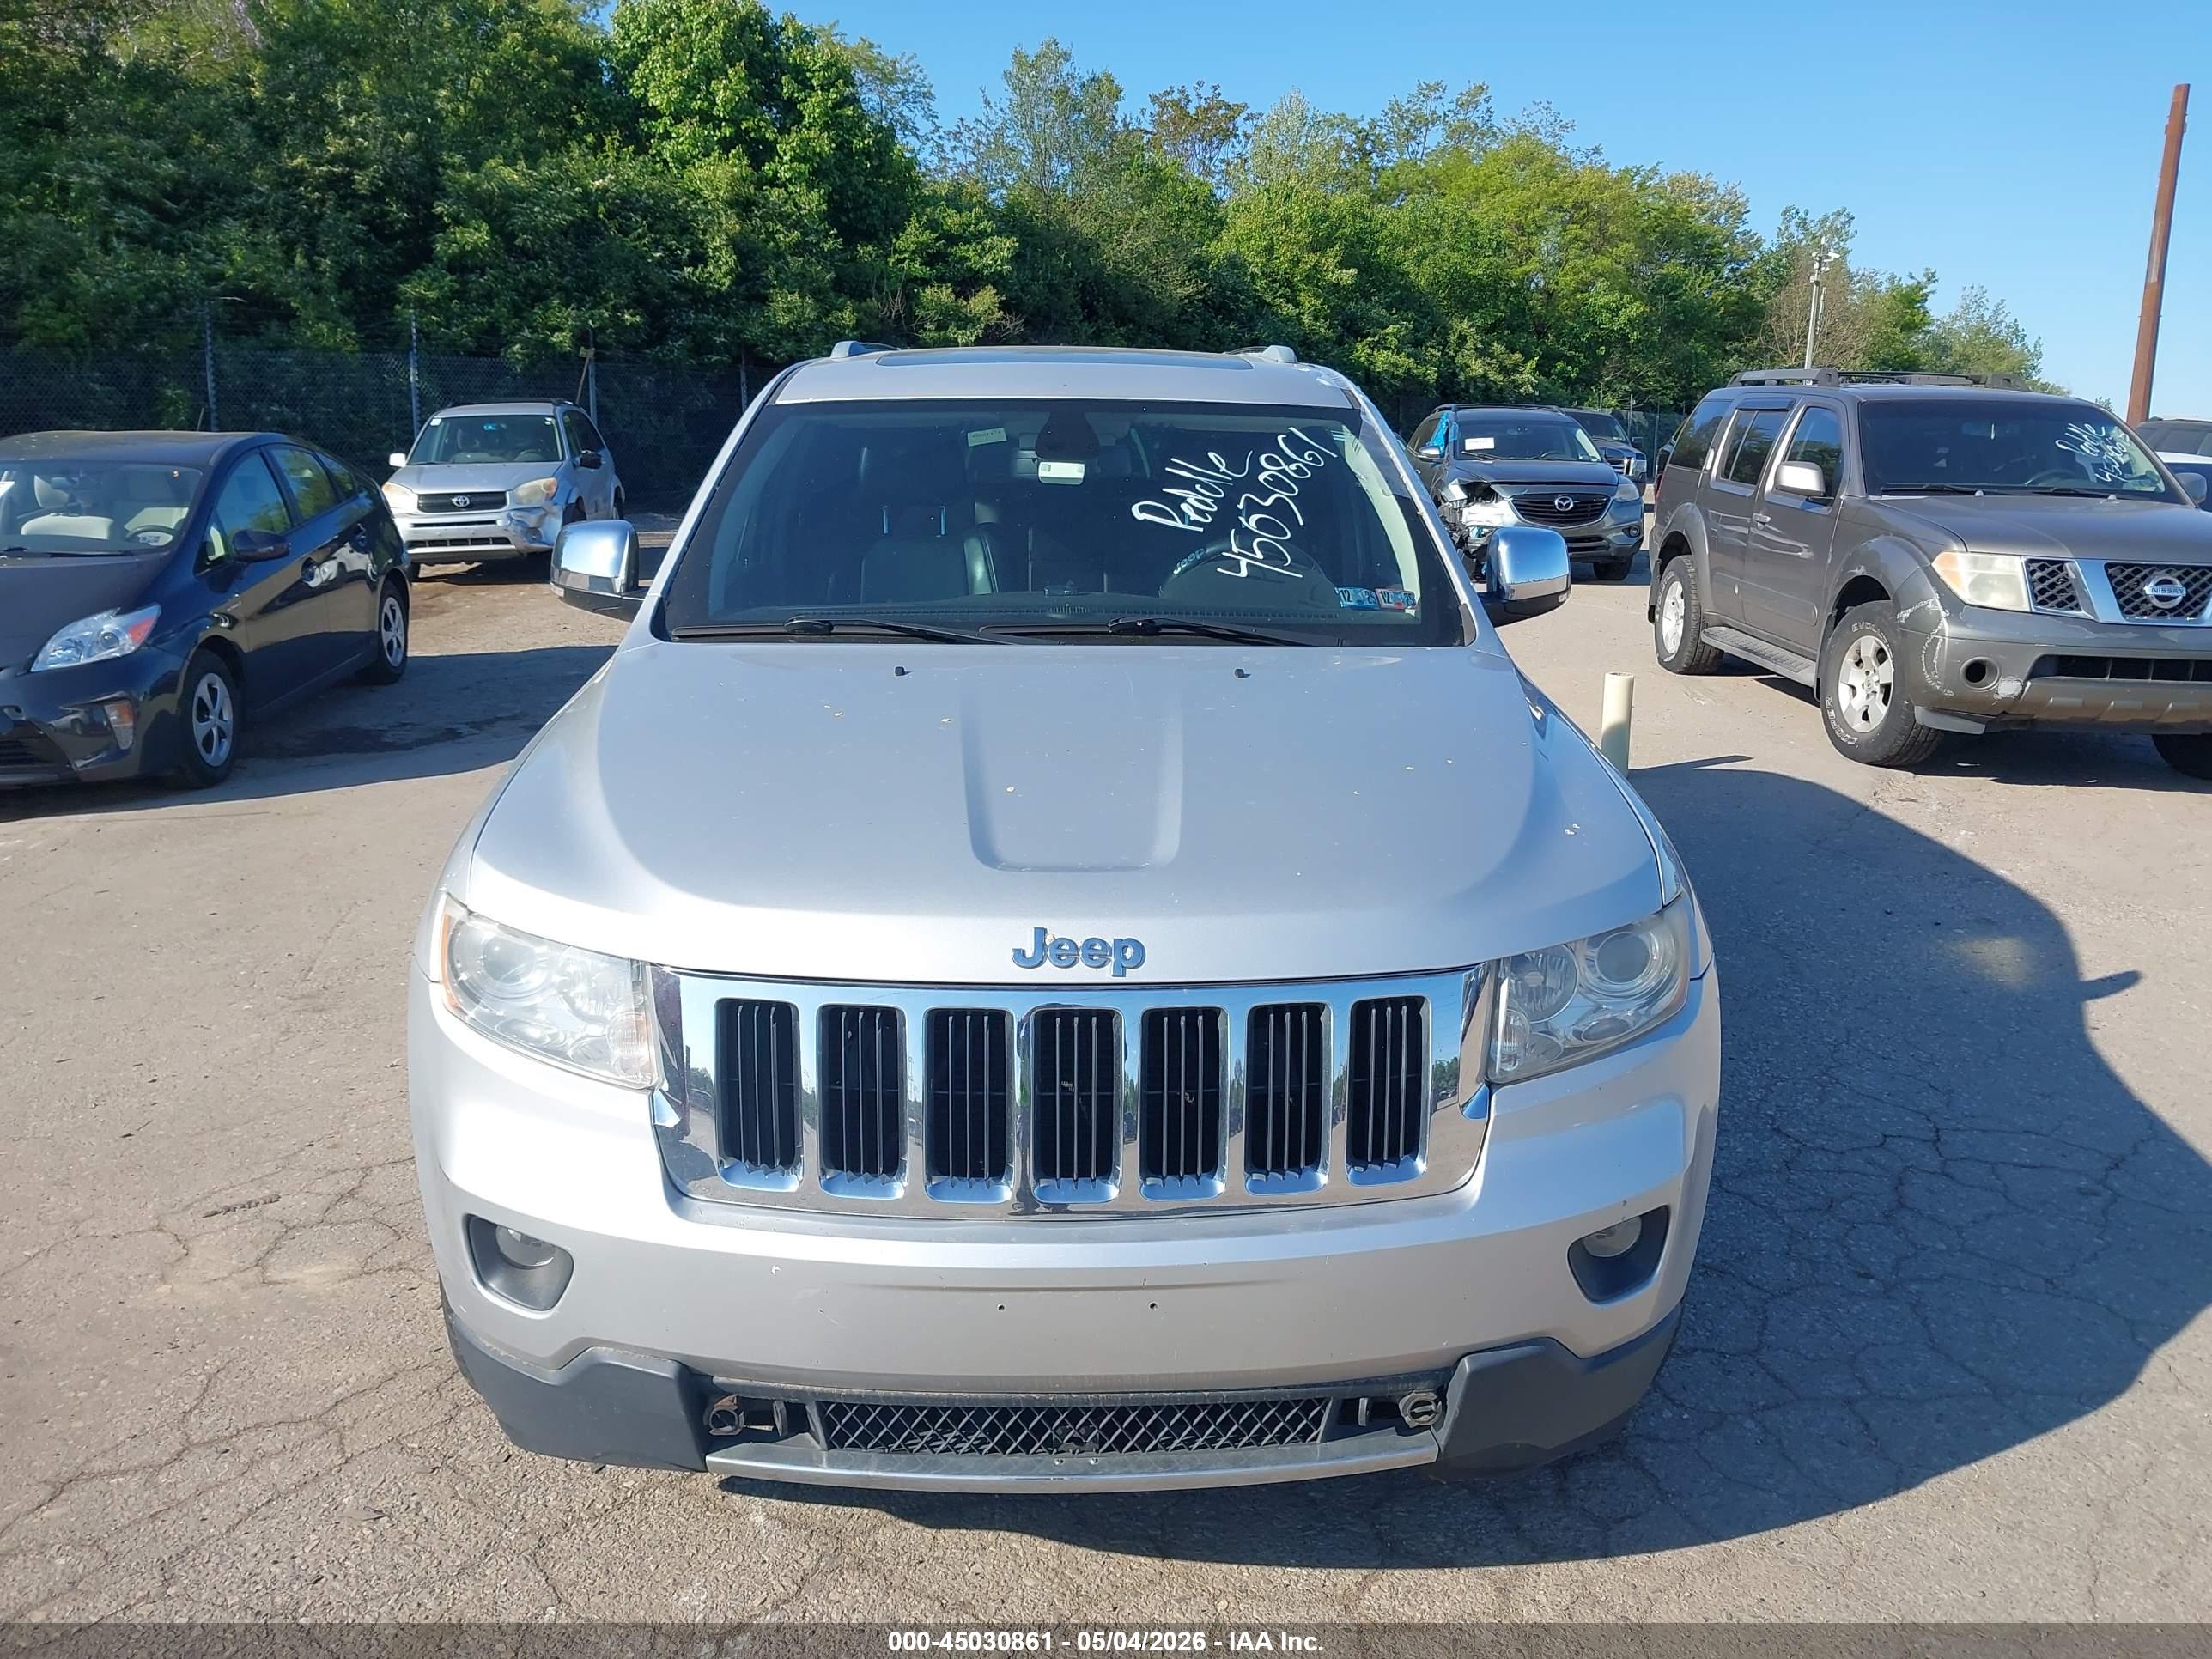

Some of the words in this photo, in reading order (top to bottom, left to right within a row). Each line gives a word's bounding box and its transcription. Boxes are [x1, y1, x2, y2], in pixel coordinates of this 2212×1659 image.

[1216, 427, 1338, 579] 45030861
[1173, 548, 1206, 575] Jeep
[1340, 589, 1353, 603] 12
[1380, 590, 1393, 605] 12
[1825, 695, 1859, 745] COOPER
[1012, 927, 1146, 978] Jeep
